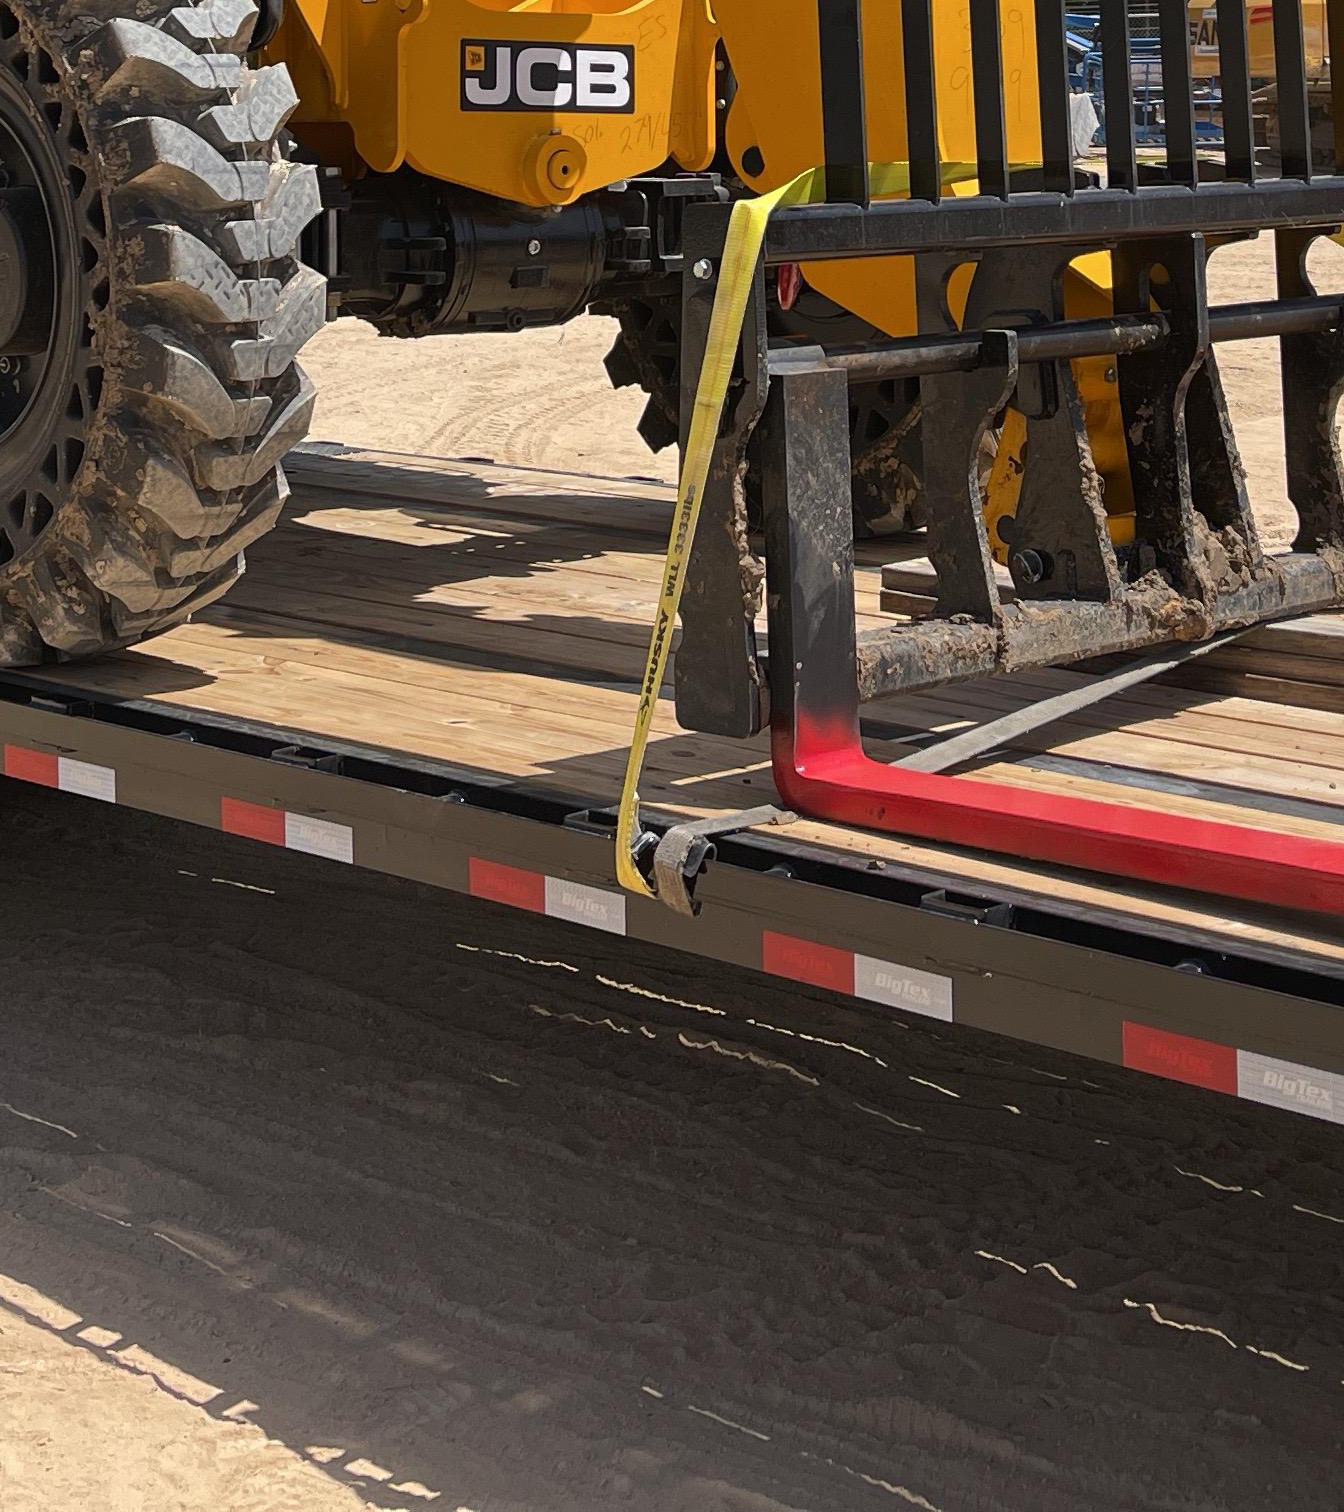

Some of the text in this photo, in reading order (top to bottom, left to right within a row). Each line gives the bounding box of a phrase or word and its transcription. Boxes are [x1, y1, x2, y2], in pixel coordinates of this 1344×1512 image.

[464, 46, 631, 107] JCB
[645, 609, 669, 695] HUSKY
[664, 561, 681, 598] WLL
[874, 972, 931, 999] BigTex
[1263, 1070, 1333, 1102] BigTex
